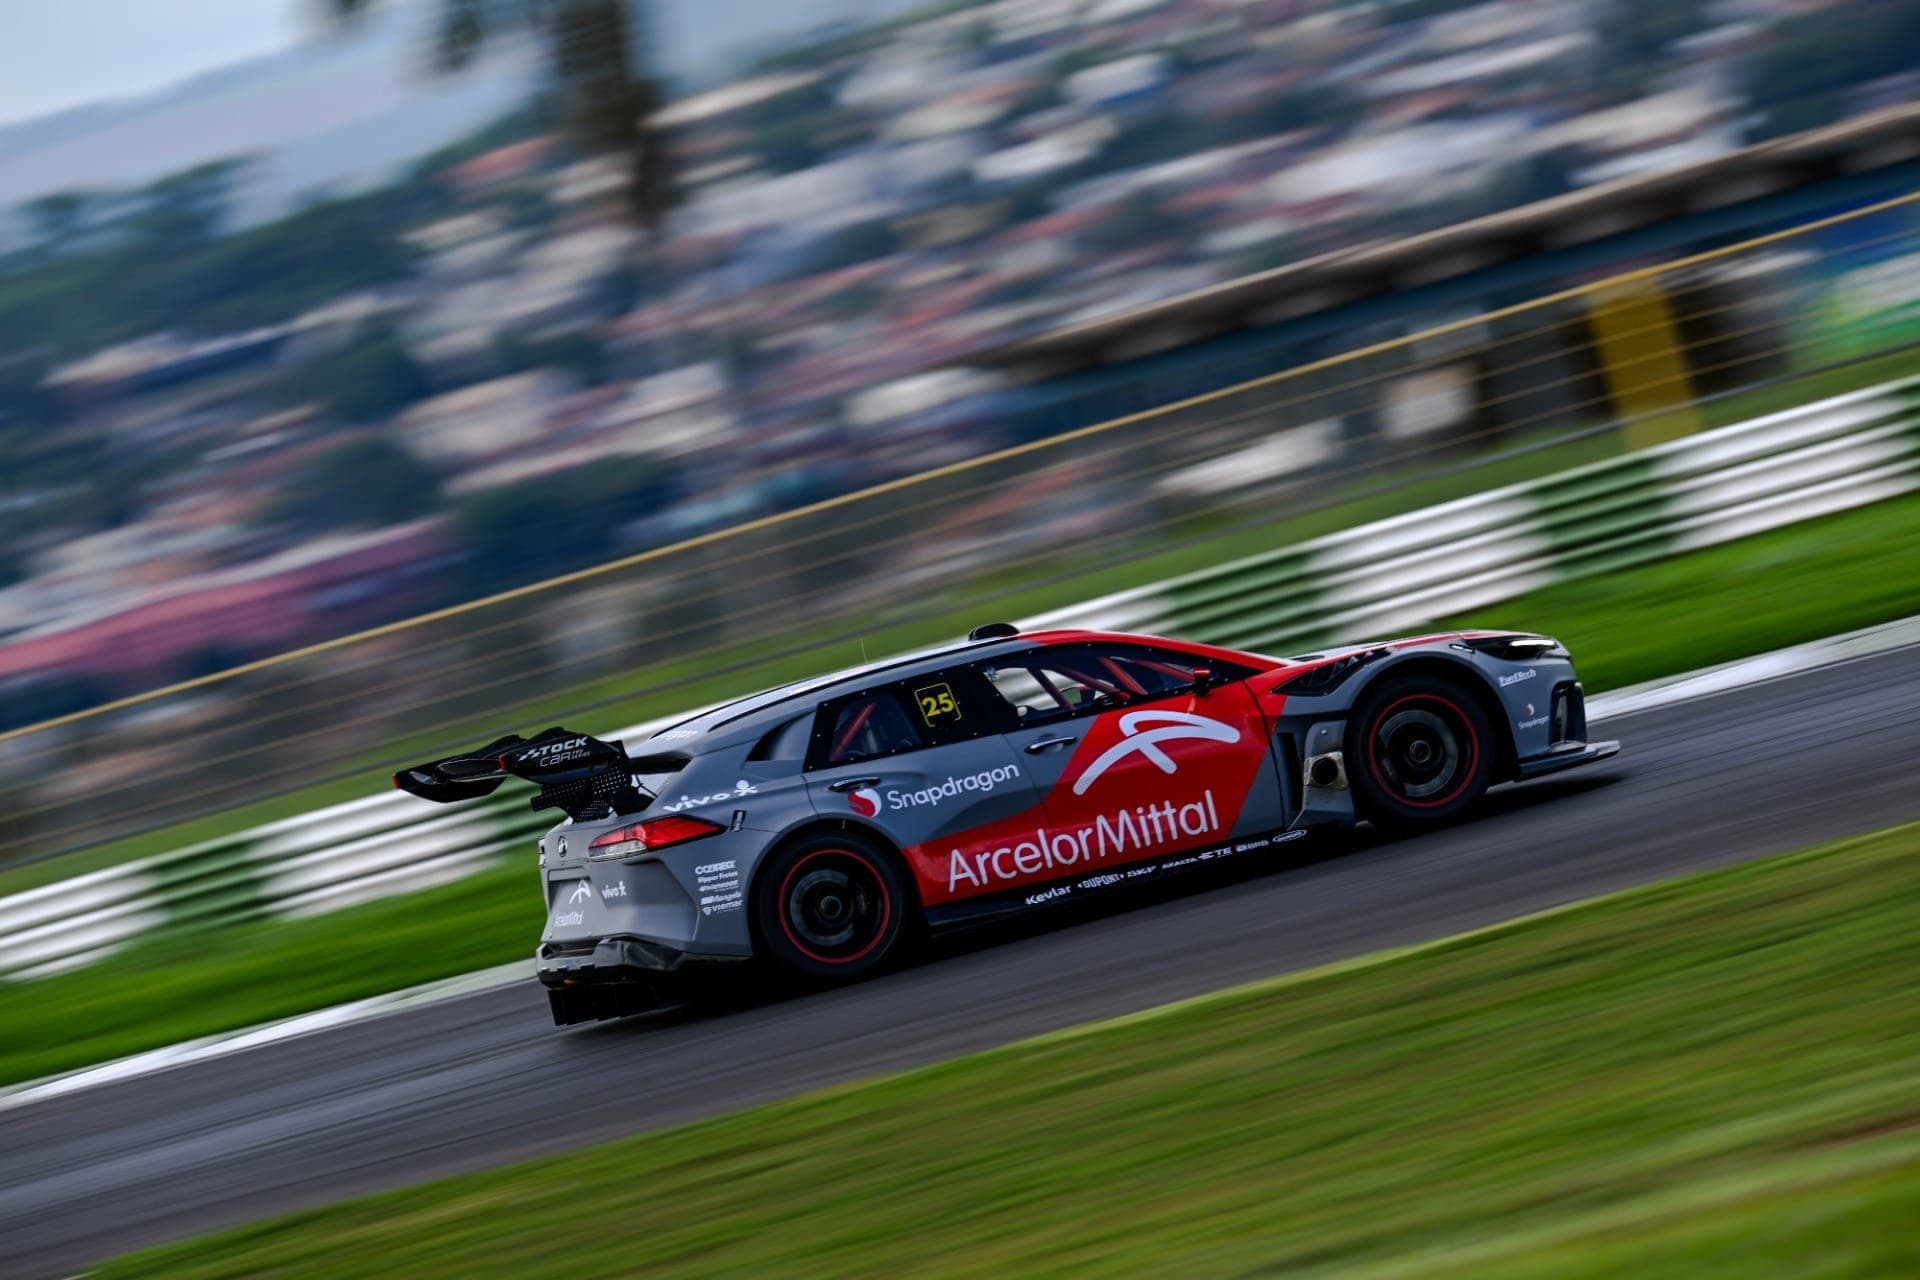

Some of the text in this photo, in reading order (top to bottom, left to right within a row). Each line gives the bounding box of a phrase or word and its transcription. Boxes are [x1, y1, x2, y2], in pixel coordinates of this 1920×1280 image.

[921, 692, 955, 718] 25
[518, 736, 588, 761] STOCK
[887, 764, 1021, 811] Snapdragon
[663, 793, 731, 812] vivo
[948, 789, 1220, 893] ArcelorMittal
[602, 884, 621, 899] vivo
[1081, 873, 1121, 889] DUPONT
[1025, 885, 1072, 905] Kevlar
